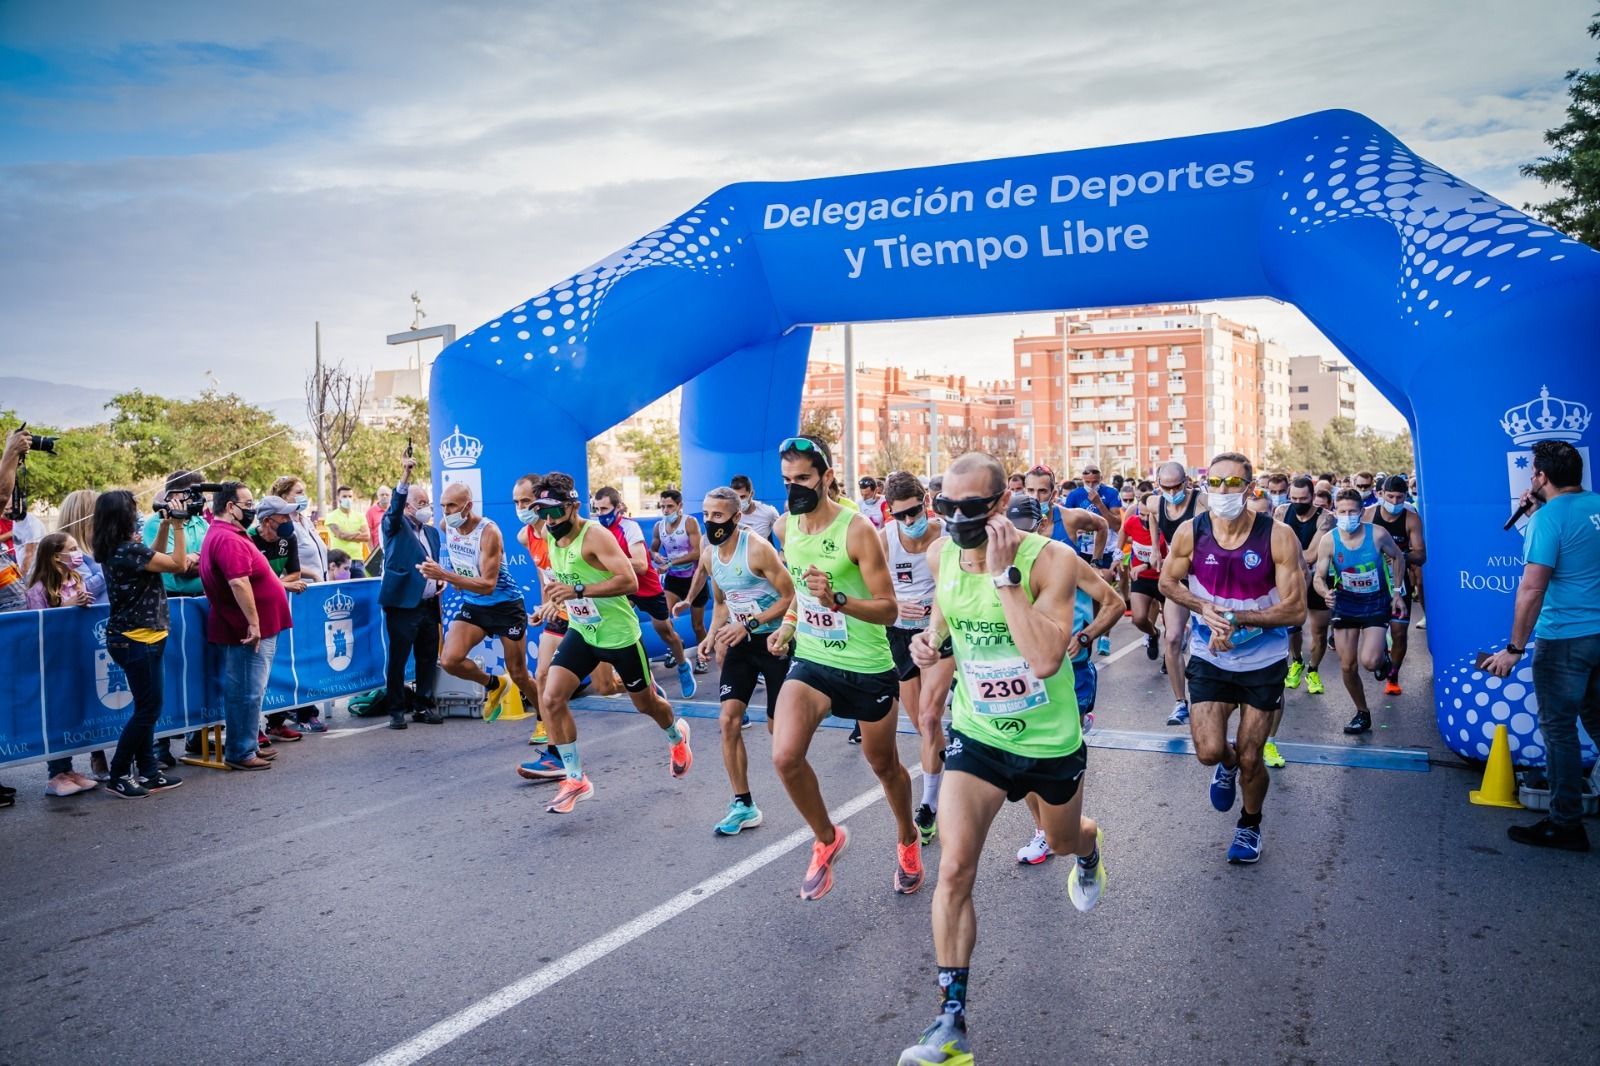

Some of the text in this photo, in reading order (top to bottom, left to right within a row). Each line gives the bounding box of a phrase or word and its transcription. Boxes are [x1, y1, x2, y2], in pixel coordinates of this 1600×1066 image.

[763, 160, 1255, 231] Delegación de Deportes
[843, 219, 1149, 279] y Tiempo Libre
[805, 610, 833, 627] 218
[981, 678, 1027, 699] 230
[265, 694, 286, 705] MAR
[994, 720, 1020, 732] VA
